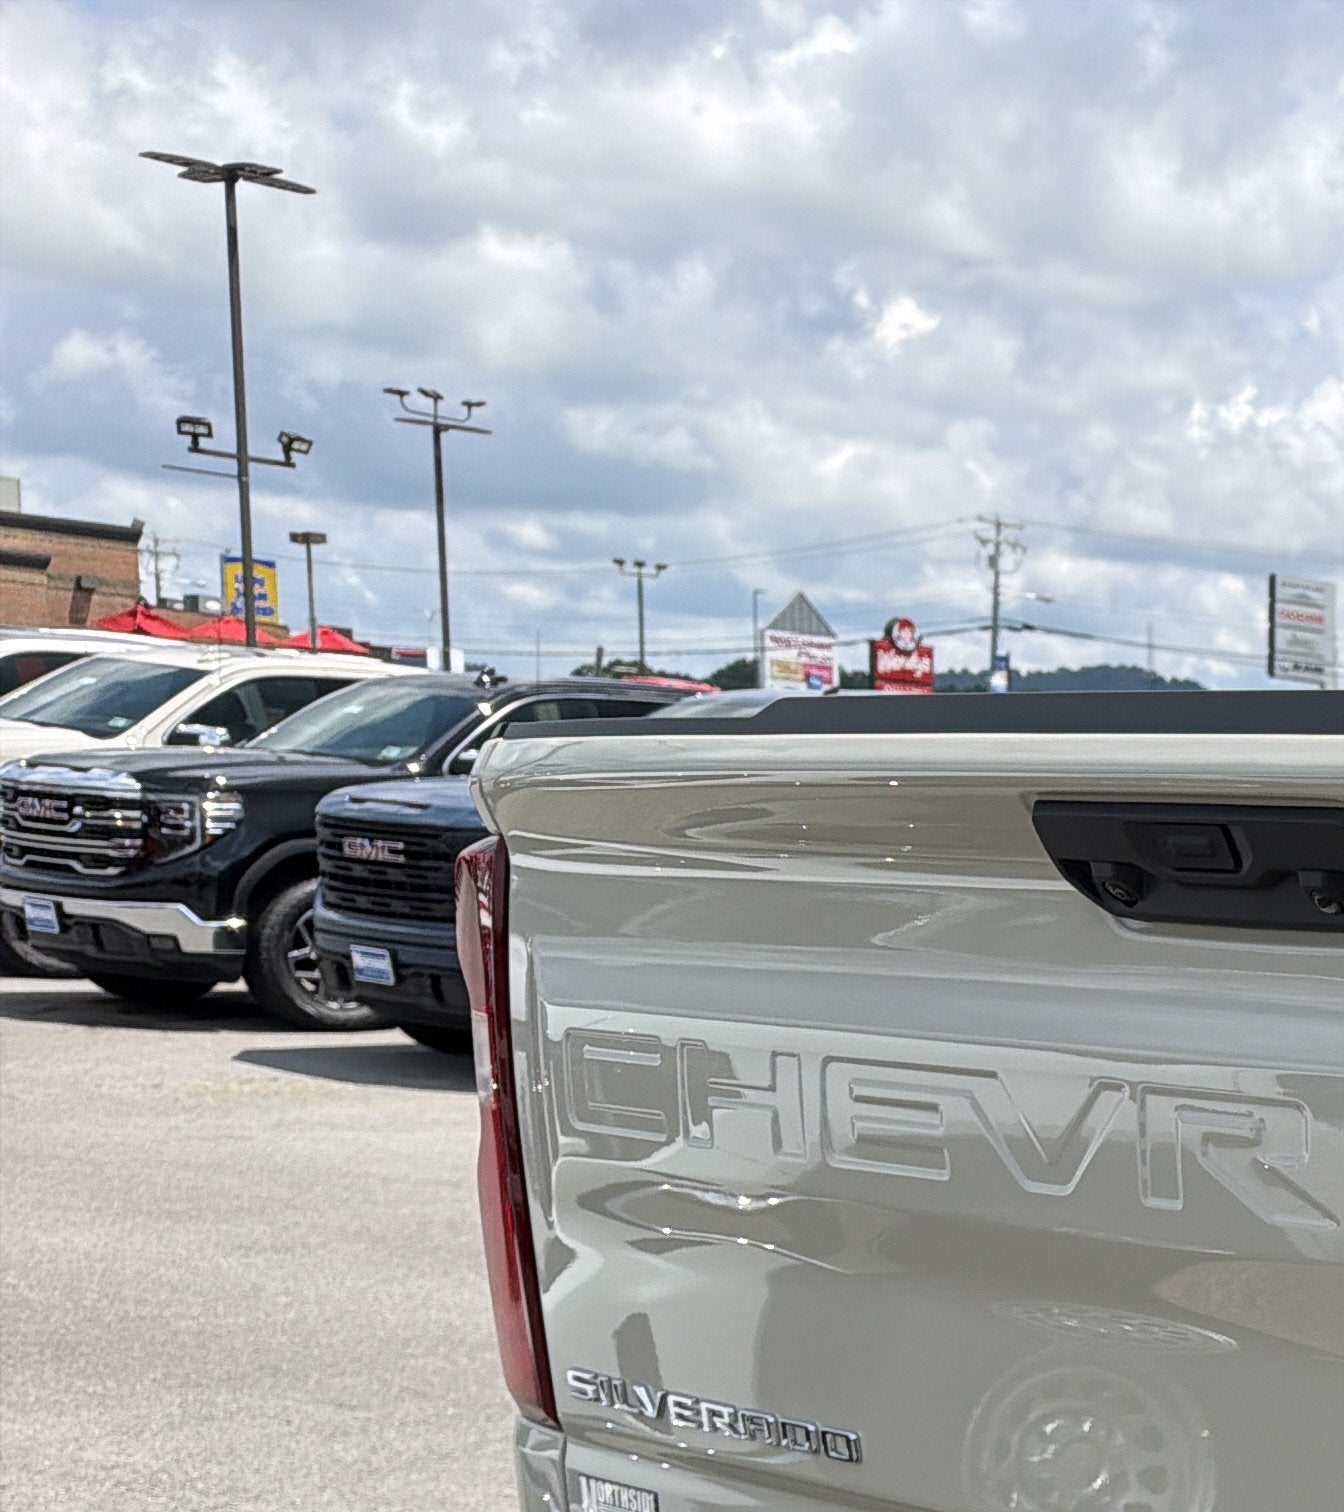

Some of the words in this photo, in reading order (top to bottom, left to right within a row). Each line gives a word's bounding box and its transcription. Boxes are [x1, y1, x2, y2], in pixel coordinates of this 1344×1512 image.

[16, 797, 69, 821] GMC
[341, 836, 406, 864] GMC
[565, 1366, 863, 1464] SILVERADO
